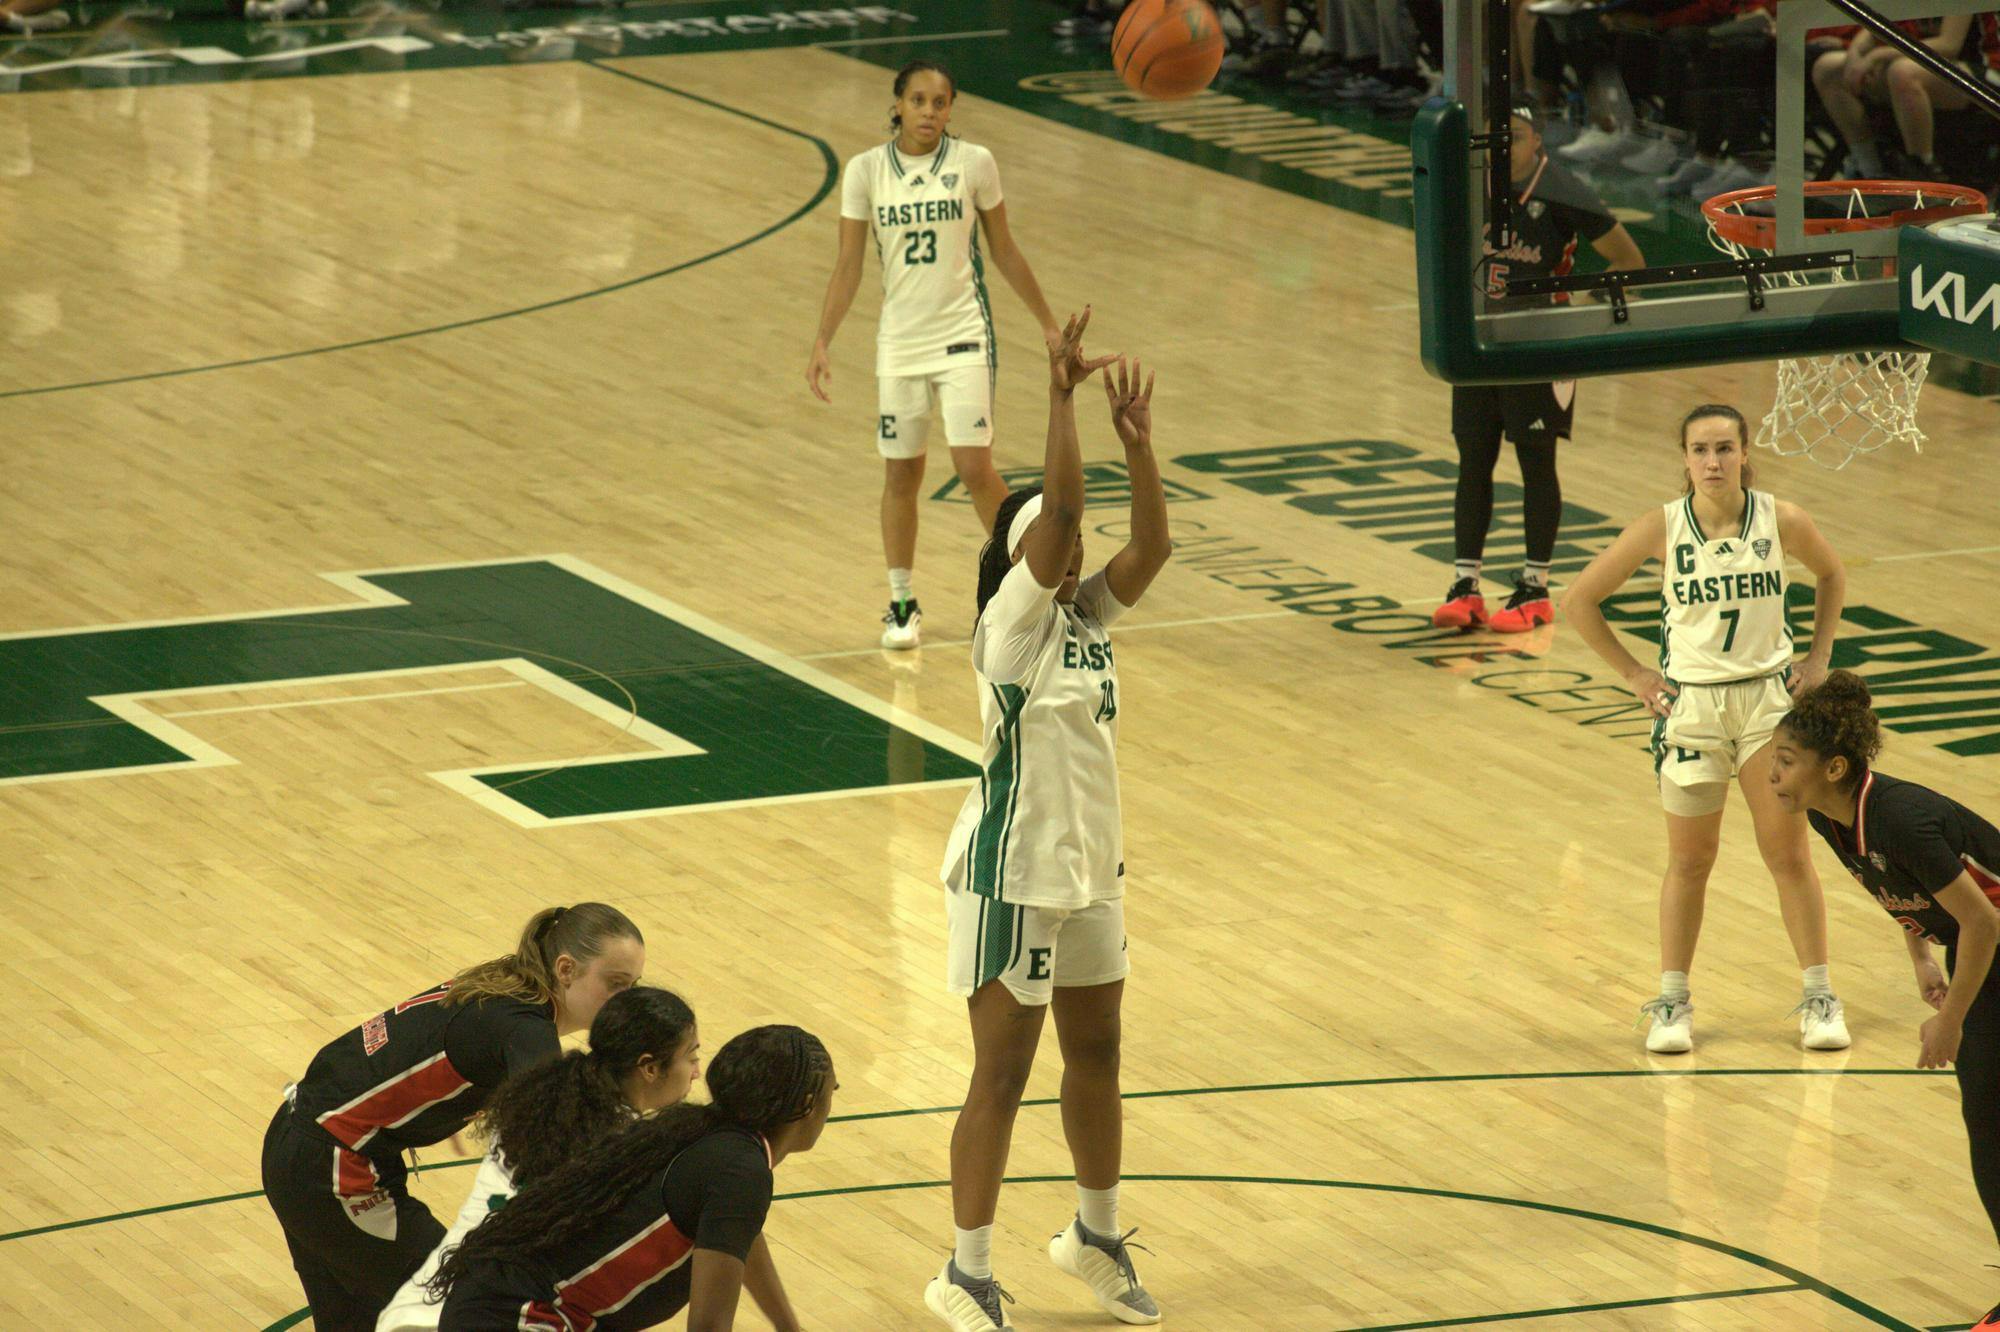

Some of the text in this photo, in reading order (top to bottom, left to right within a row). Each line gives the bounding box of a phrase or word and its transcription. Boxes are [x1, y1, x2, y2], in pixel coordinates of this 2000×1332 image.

[878, 199, 963, 226] EASTERN
[904, 229, 937, 265] 23
[1488, 263, 1510, 299] 5
[879, 415, 897, 439] E
[1676, 543, 1696, 575] C
[1673, 570, 1782, 605] EASTERN
[1719, 608, 1740, 652] 7
[1026, 947, 1051, 981] E
